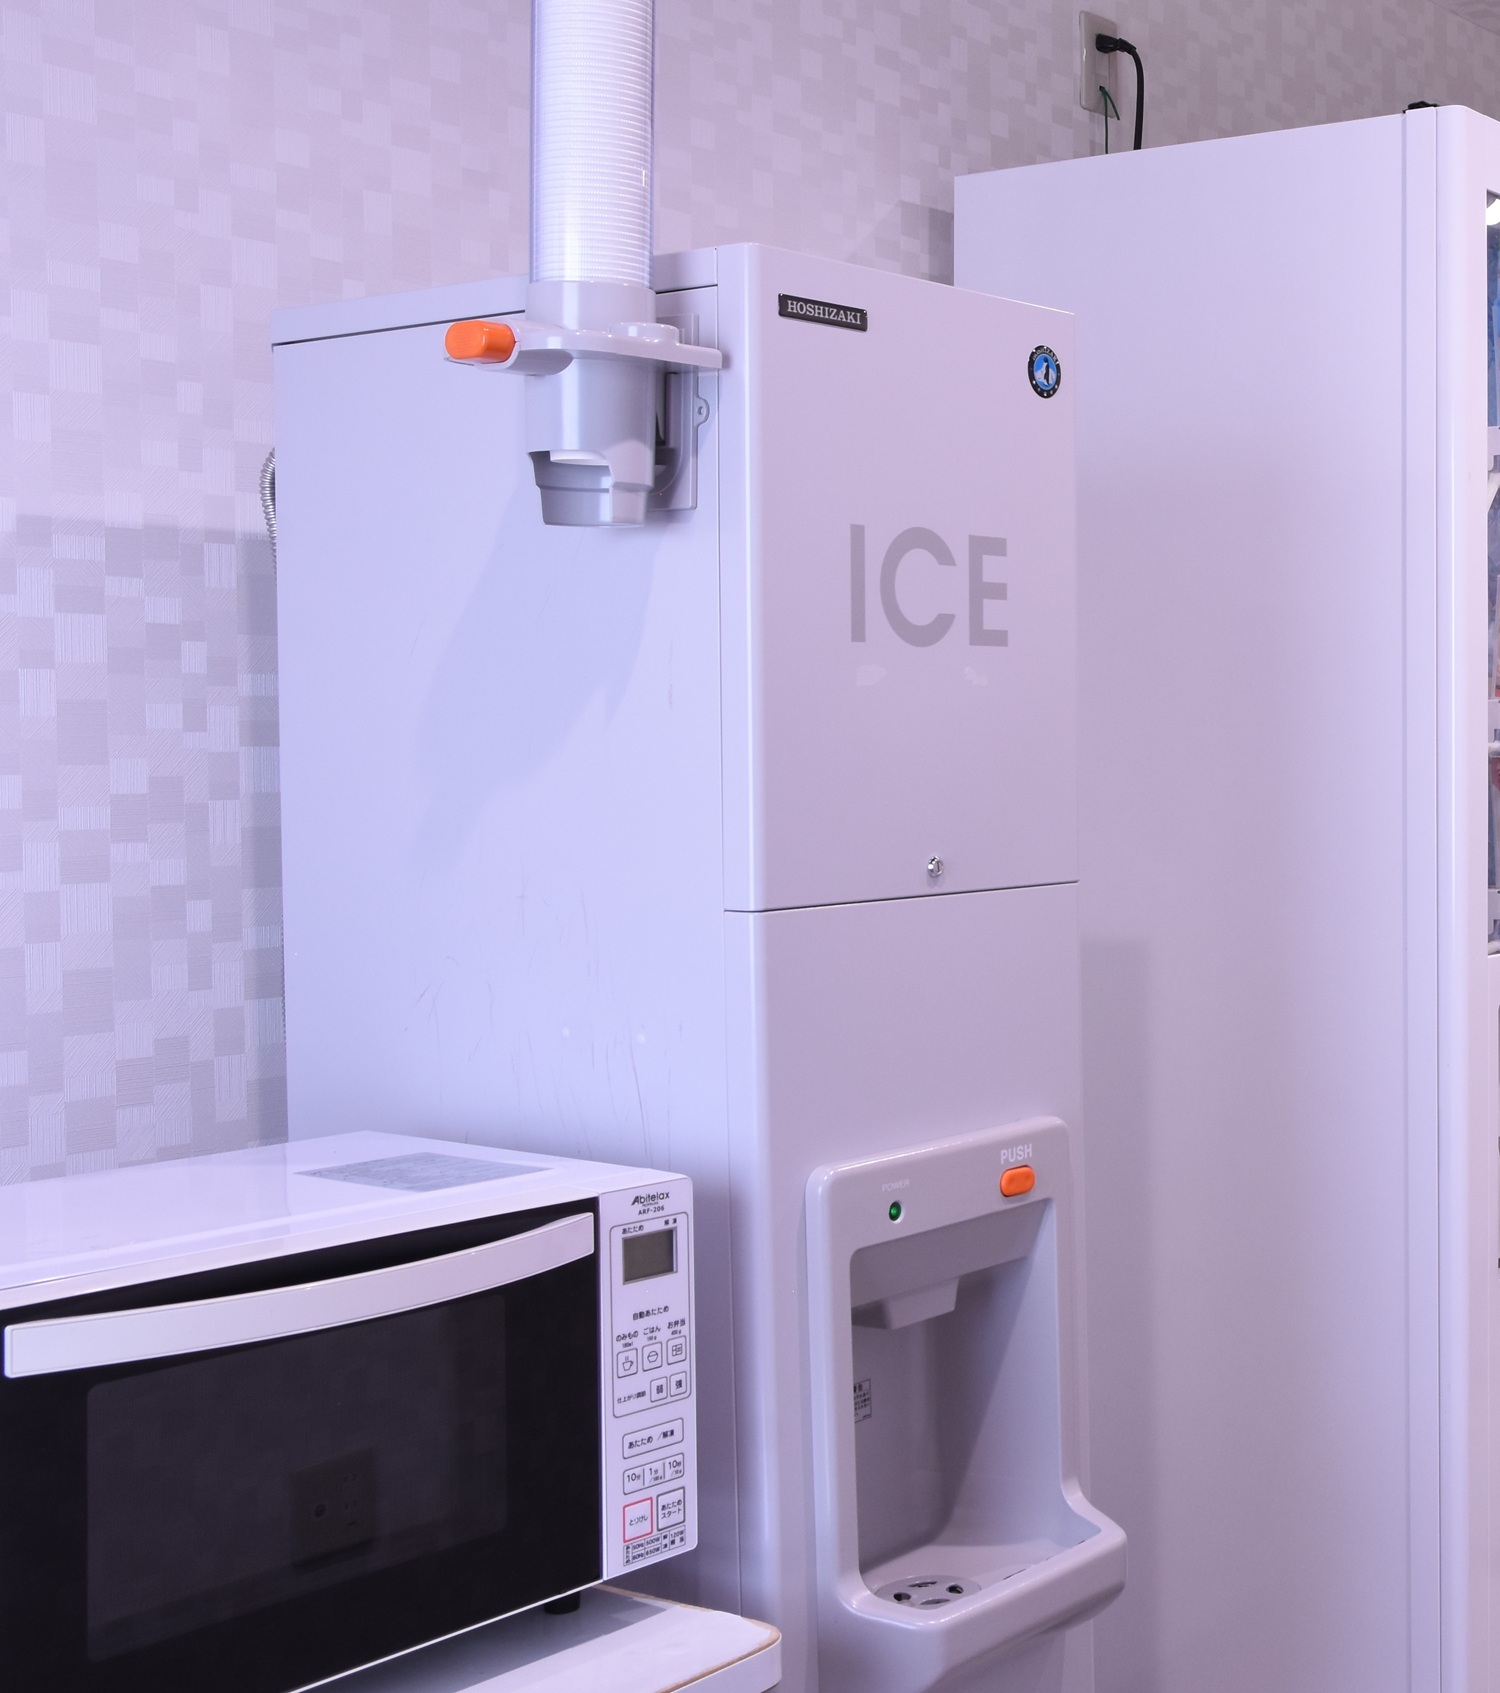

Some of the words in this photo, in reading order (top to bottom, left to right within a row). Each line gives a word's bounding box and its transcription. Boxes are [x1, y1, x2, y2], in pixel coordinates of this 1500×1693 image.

[787, 300, 861, 325] HOSHIZAKI
[849, 523, 1009, 647] ICE
[1000, 1144, 1033, 1164] PUSH
[881, 1179, 910, 1192] POWER
[631, 1191, 670, 1206] Abitelax
[638, 1205, 665, 1216] ARF-206
[622, 1225, 644, 1235] あたため
[633, 1305, 669, 1321] 自動あたため
[667, 1318, 686, 1330] お弁当
[616, 1330, 639, 1342] のみもの
[643, 1326, 661, 1336] ごはん
[628, 1436, 653, 1449] あたため
[661, 1499, 682, 1511] あたため
[661, 1508, 682, 1519] スタート
[629, 1515, 648, 1526] とりけし
